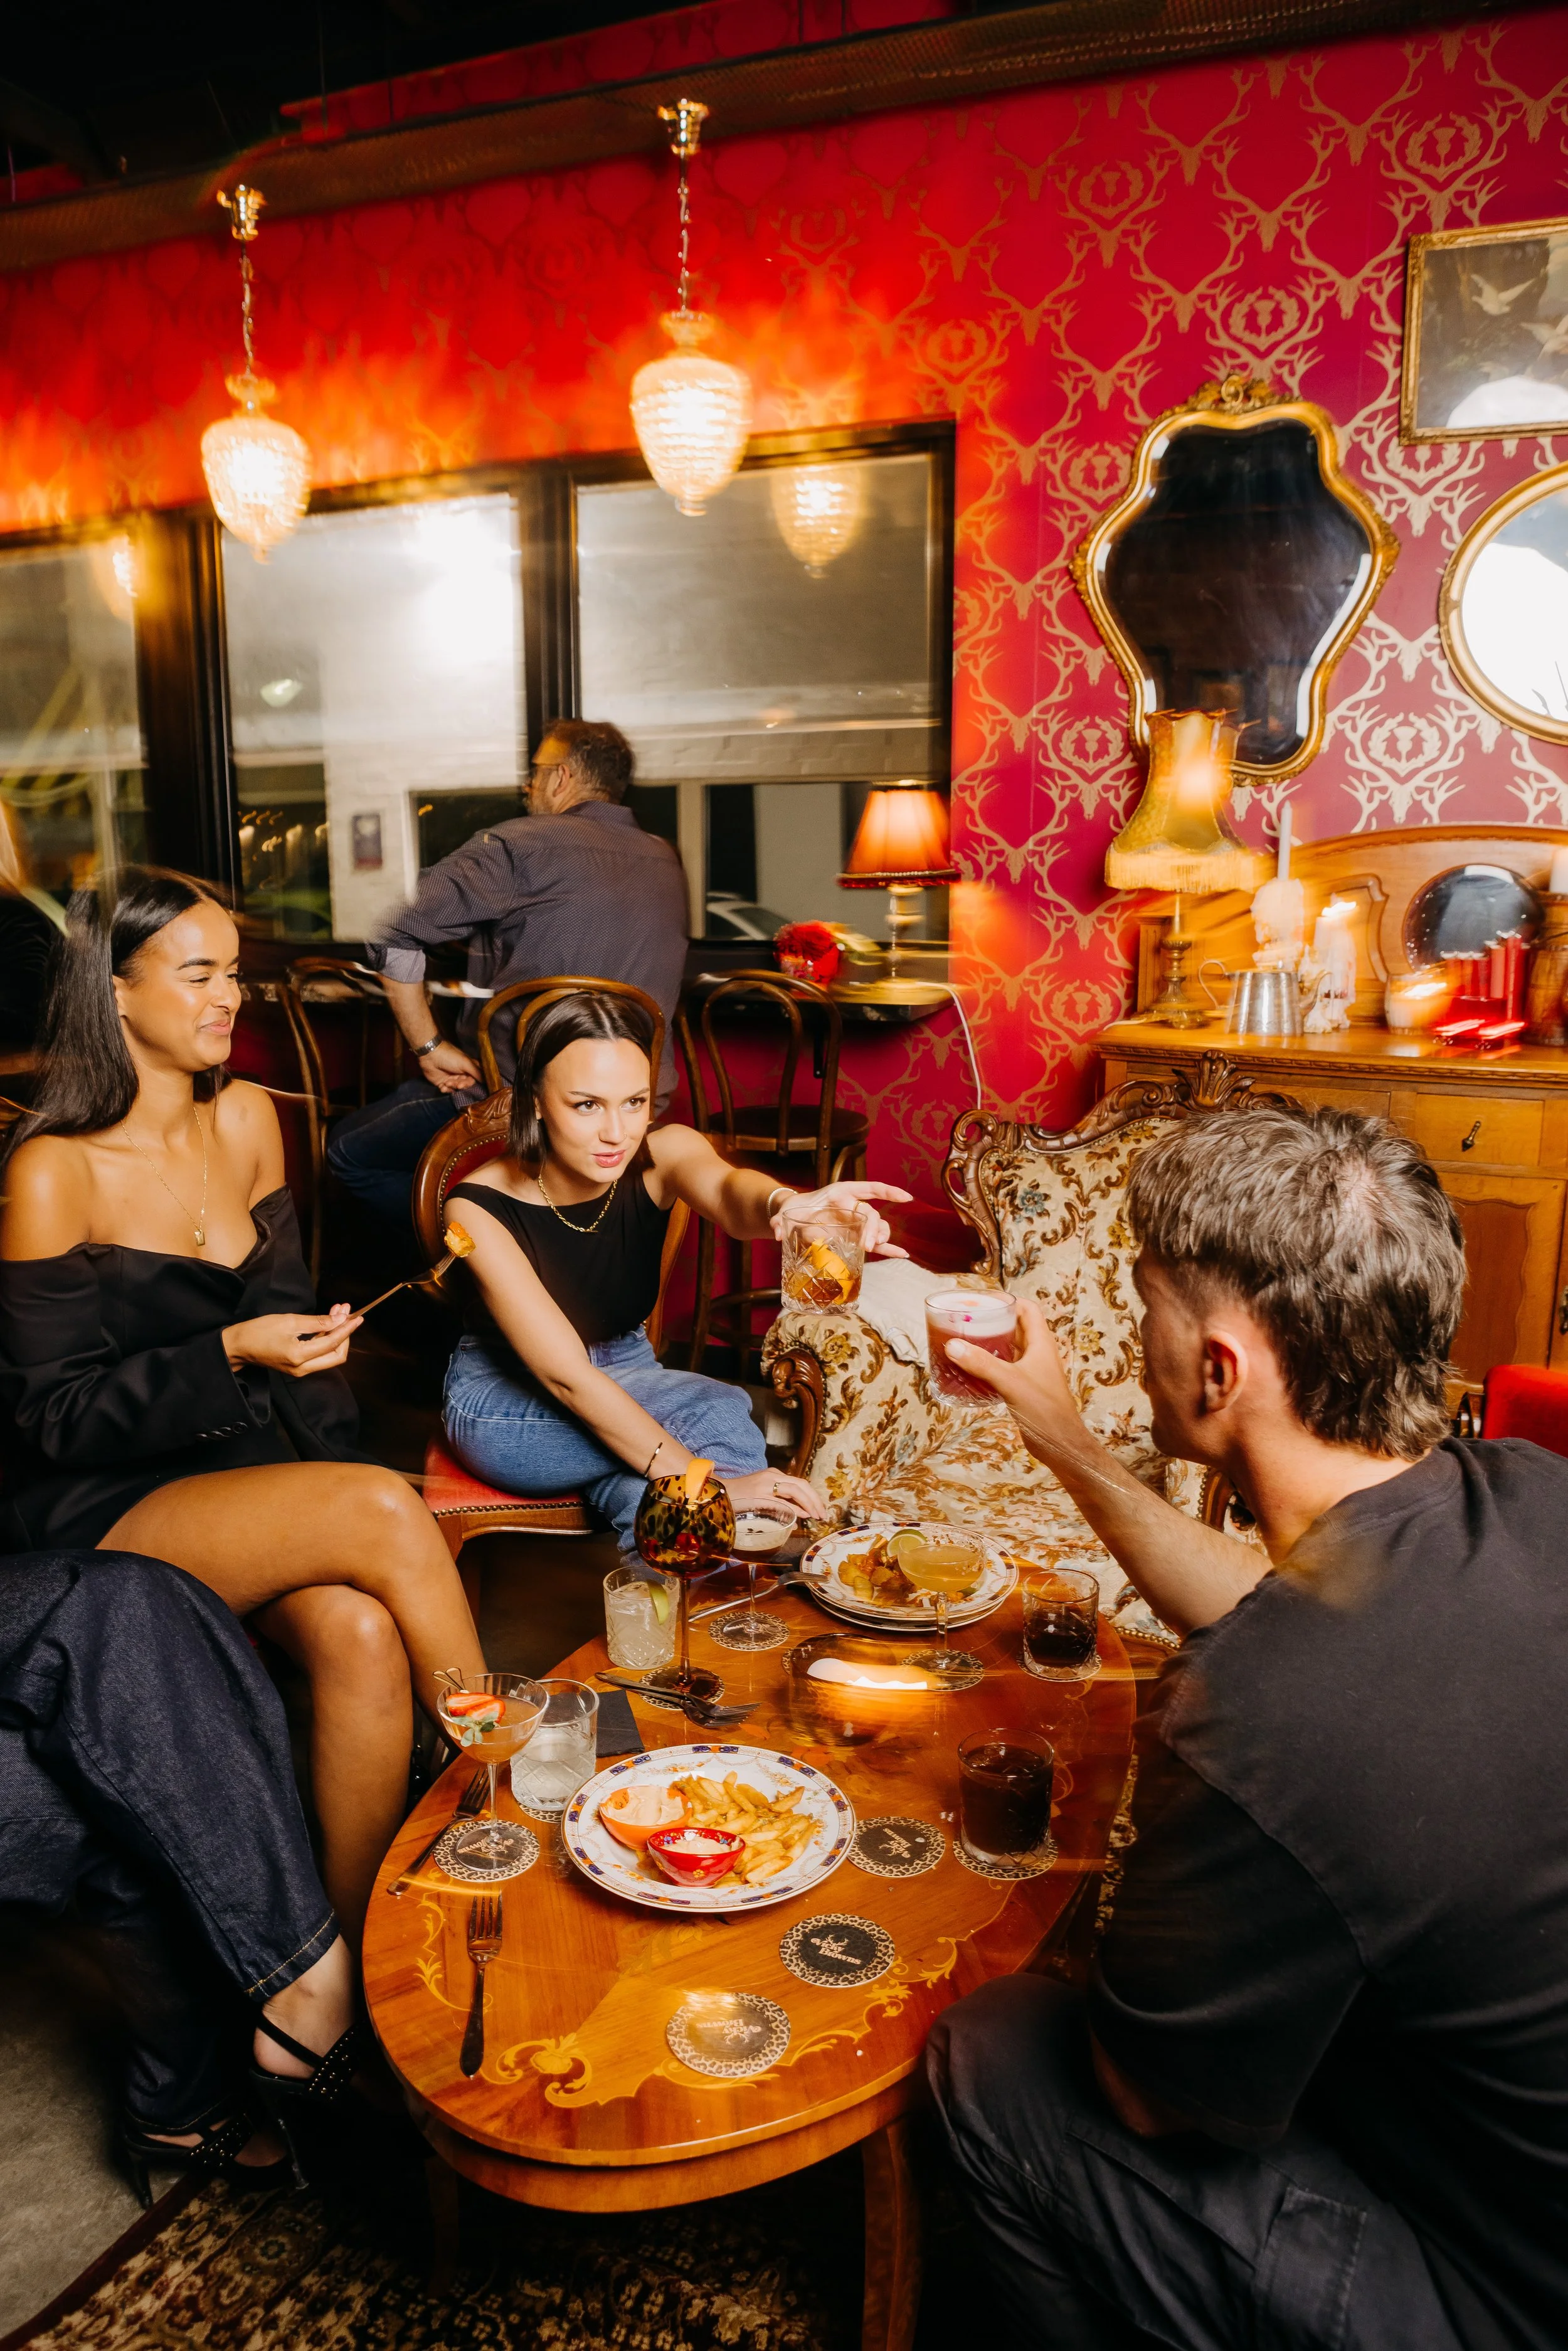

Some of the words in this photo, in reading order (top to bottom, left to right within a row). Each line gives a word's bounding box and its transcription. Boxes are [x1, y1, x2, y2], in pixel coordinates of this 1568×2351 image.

[810, 1938, 845, 1953] Vicky
[818, 1947, 862, 1965] Browns
[696, 2019, 744, 2028] Browns
[722, 2025, 761, 2034] Vicky
